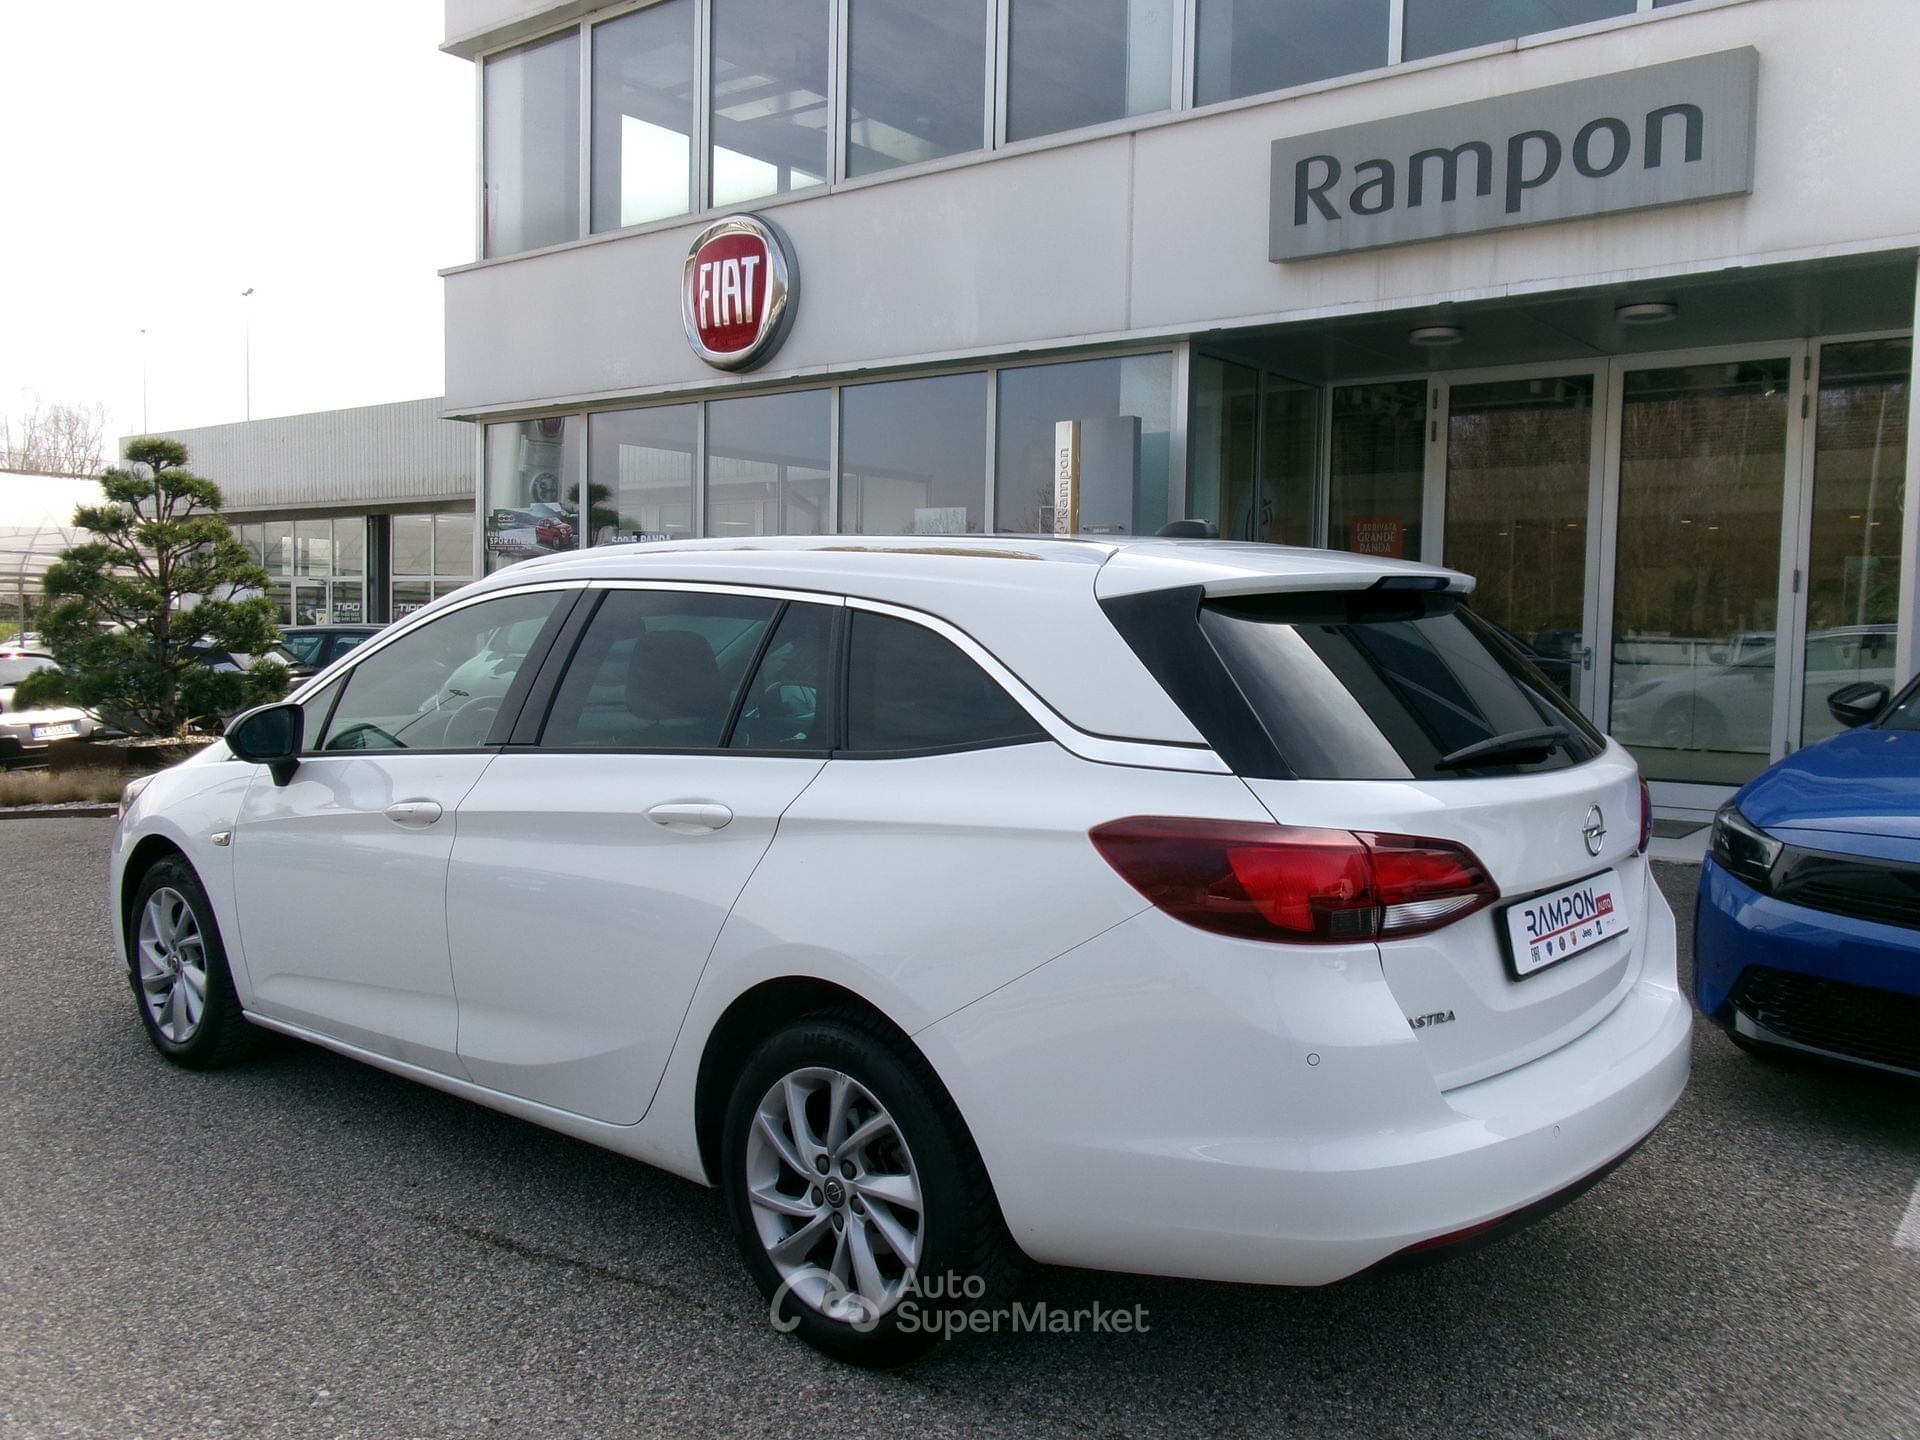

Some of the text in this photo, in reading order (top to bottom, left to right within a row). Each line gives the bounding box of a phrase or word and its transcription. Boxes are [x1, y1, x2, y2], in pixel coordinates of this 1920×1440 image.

[1294, 102, 1704, 226] Rampon
[700, 255, 760, 329] FIAT
[1057, 447, 1072, 519] Rampon
[640, 534, 671, 543] PANDA
[1357, 531, 1396, 542] GRANDE
[1359, 542, 1391, 553] PANDA
[335, 602, 361, 611] TIPO
[1524, 887, 1596, 937] RAMPON
[1581, 928, 1593, 939] Jeep
